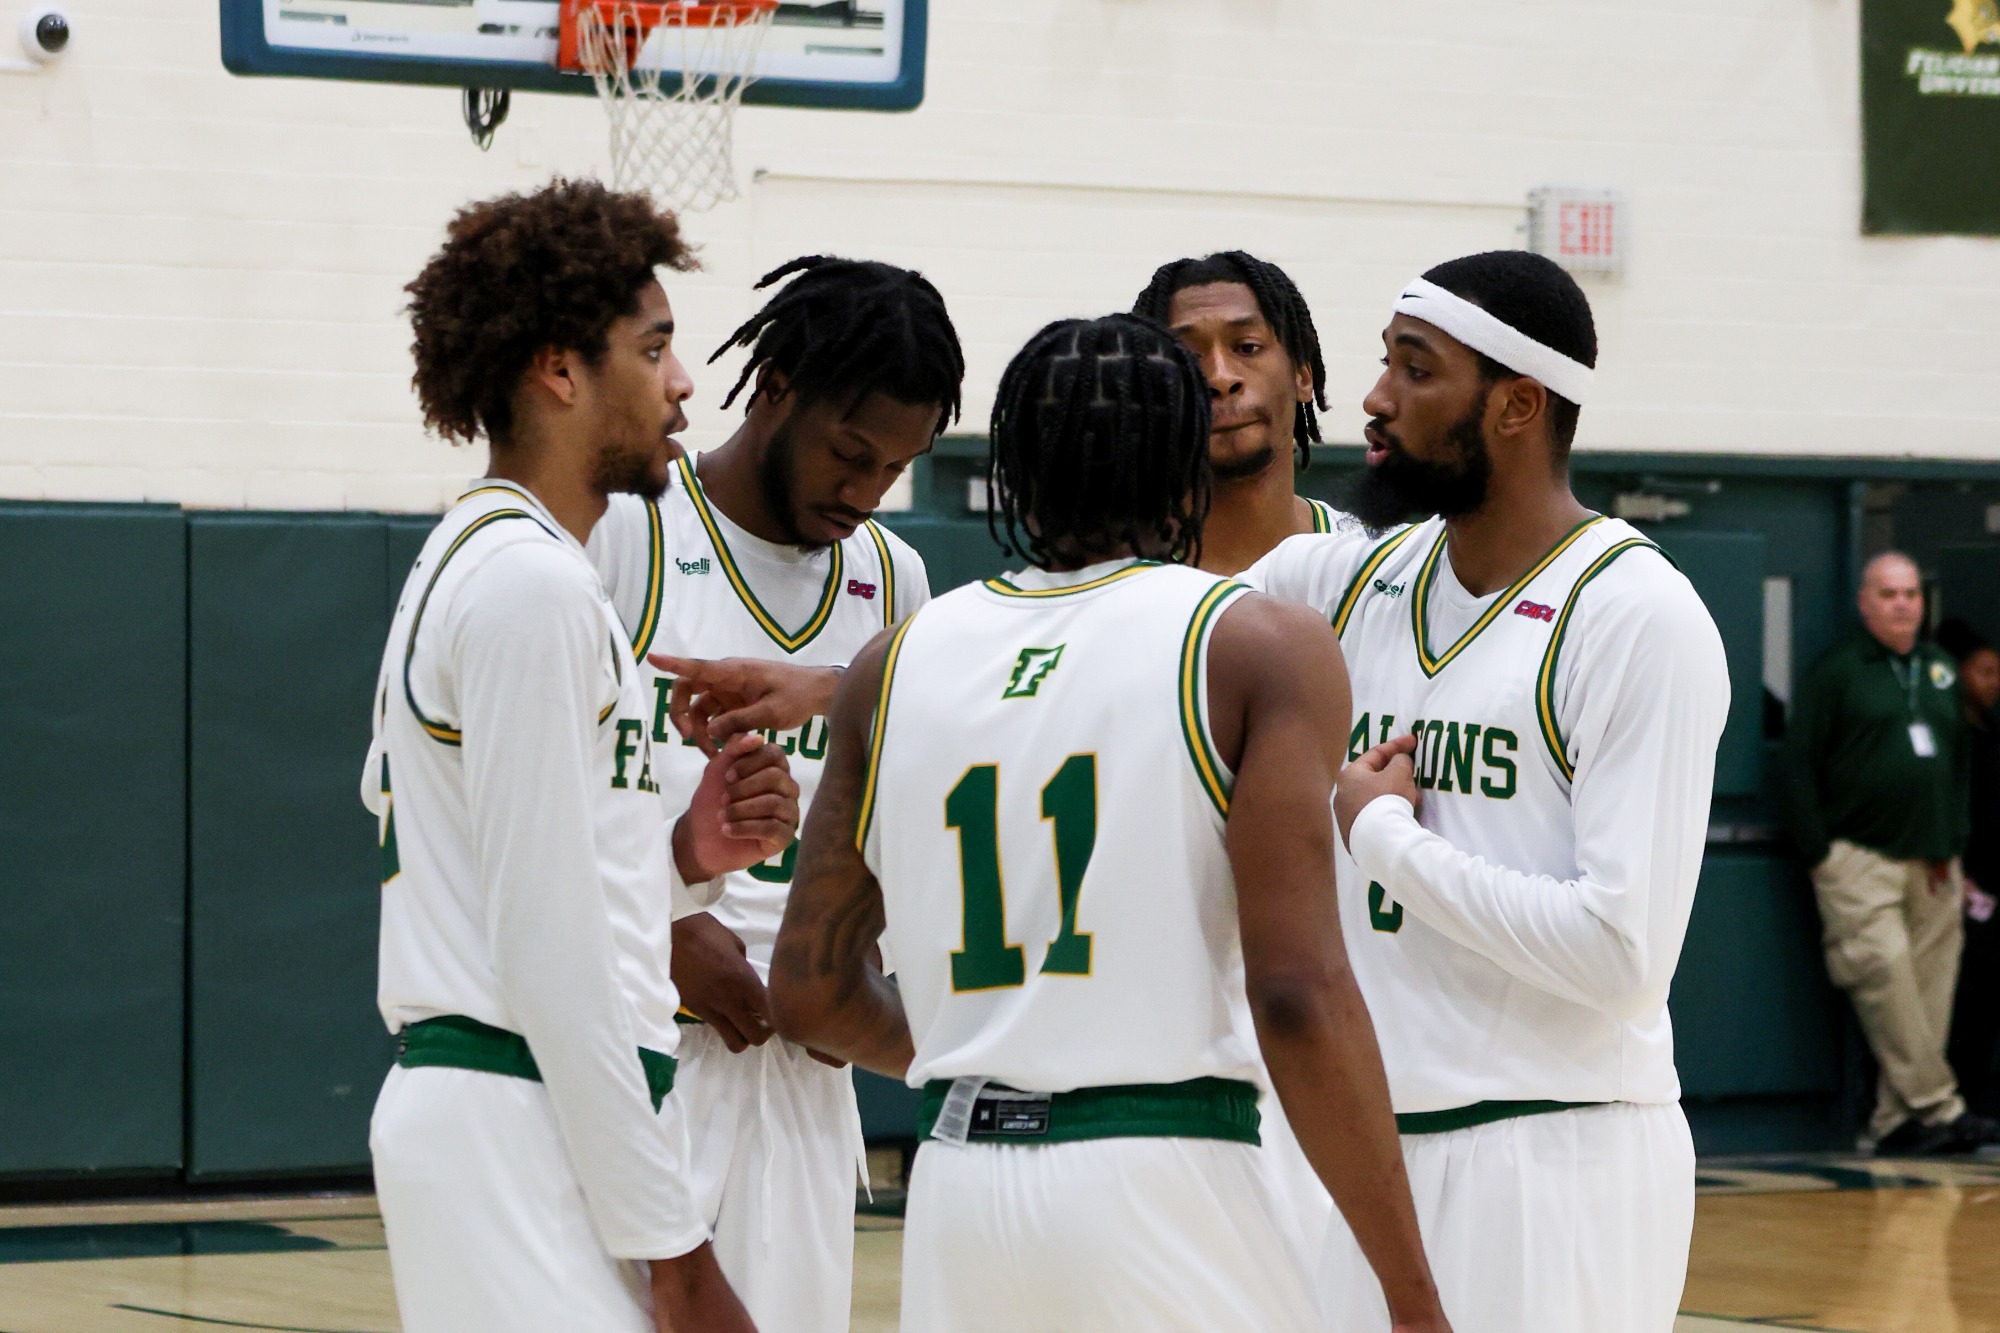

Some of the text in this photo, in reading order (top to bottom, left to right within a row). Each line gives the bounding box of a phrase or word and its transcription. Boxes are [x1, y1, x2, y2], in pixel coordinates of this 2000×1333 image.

[675, 557, 710, 574] pelli
[1002, 643, 1067, 700] F
[611, 718, 660, 795] FA
[944, 751, 1098, 995] 11
